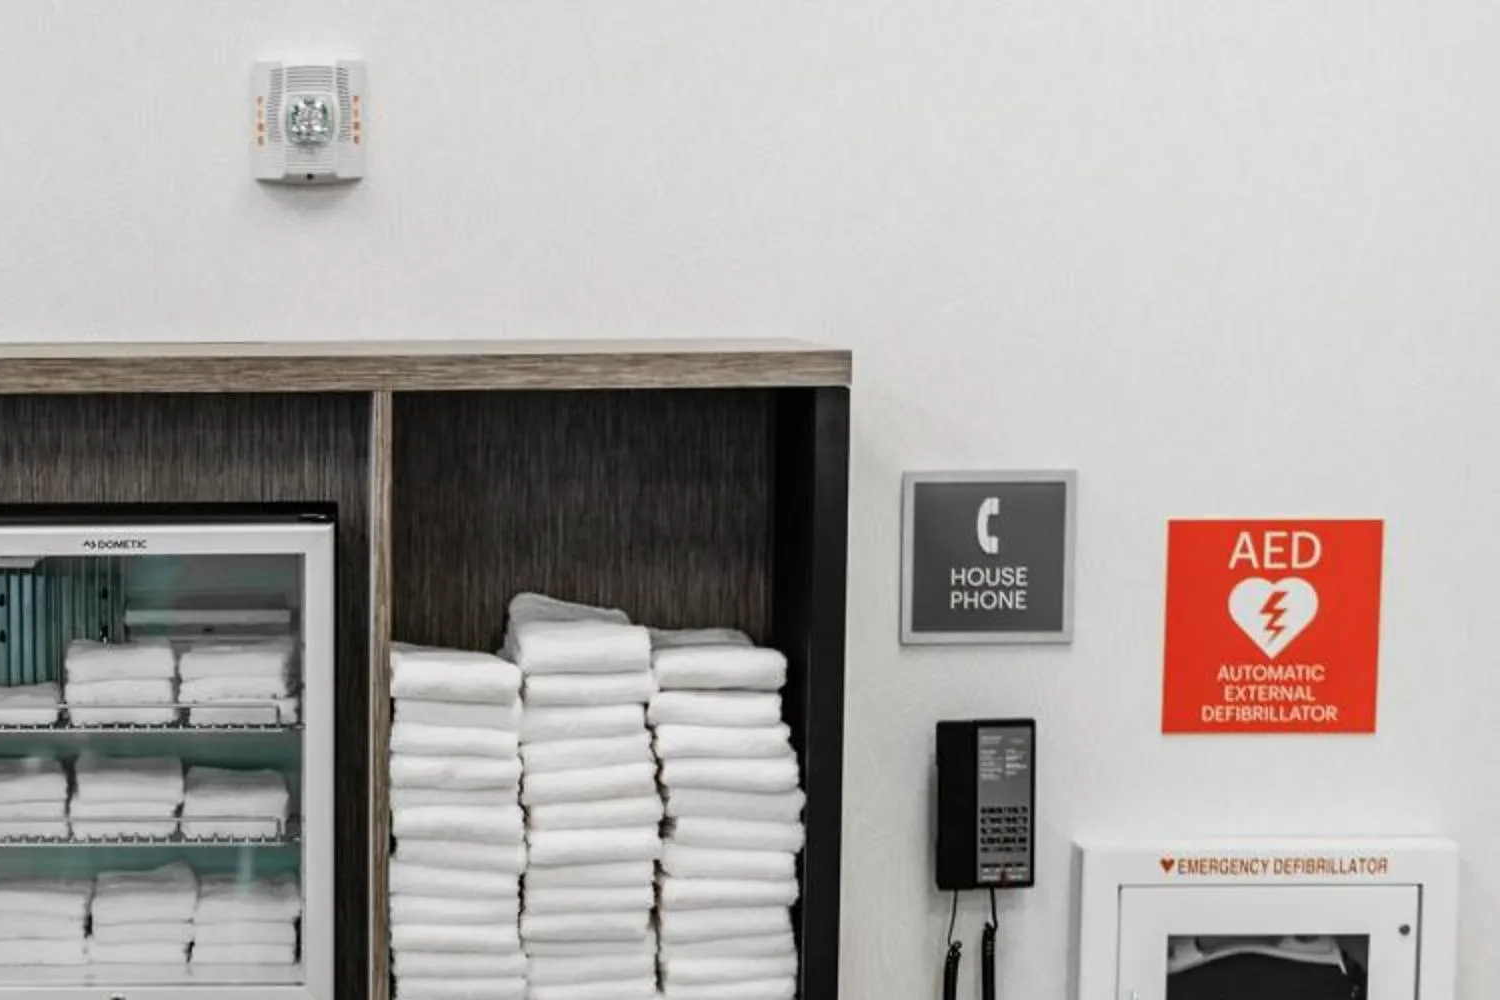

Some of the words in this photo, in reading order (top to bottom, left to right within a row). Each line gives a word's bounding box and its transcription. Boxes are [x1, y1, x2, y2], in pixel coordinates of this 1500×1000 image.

[1228, 531, 1323, 570] AED
[950, 566, 1029, 587] HOUSE
[950, 590, 1028, 610] PHONE
[1217, 664, 1325, 681] AUTOMATIC
[1223, 685, 1316, 702] EXTERNAL
[1201, 704, 1338, 722] DEFIBRILLATOR
[1177, 858, 1269, 875] EMERGENCY
[1273, 858, 1389, 875] DEFIBRILLATOR
